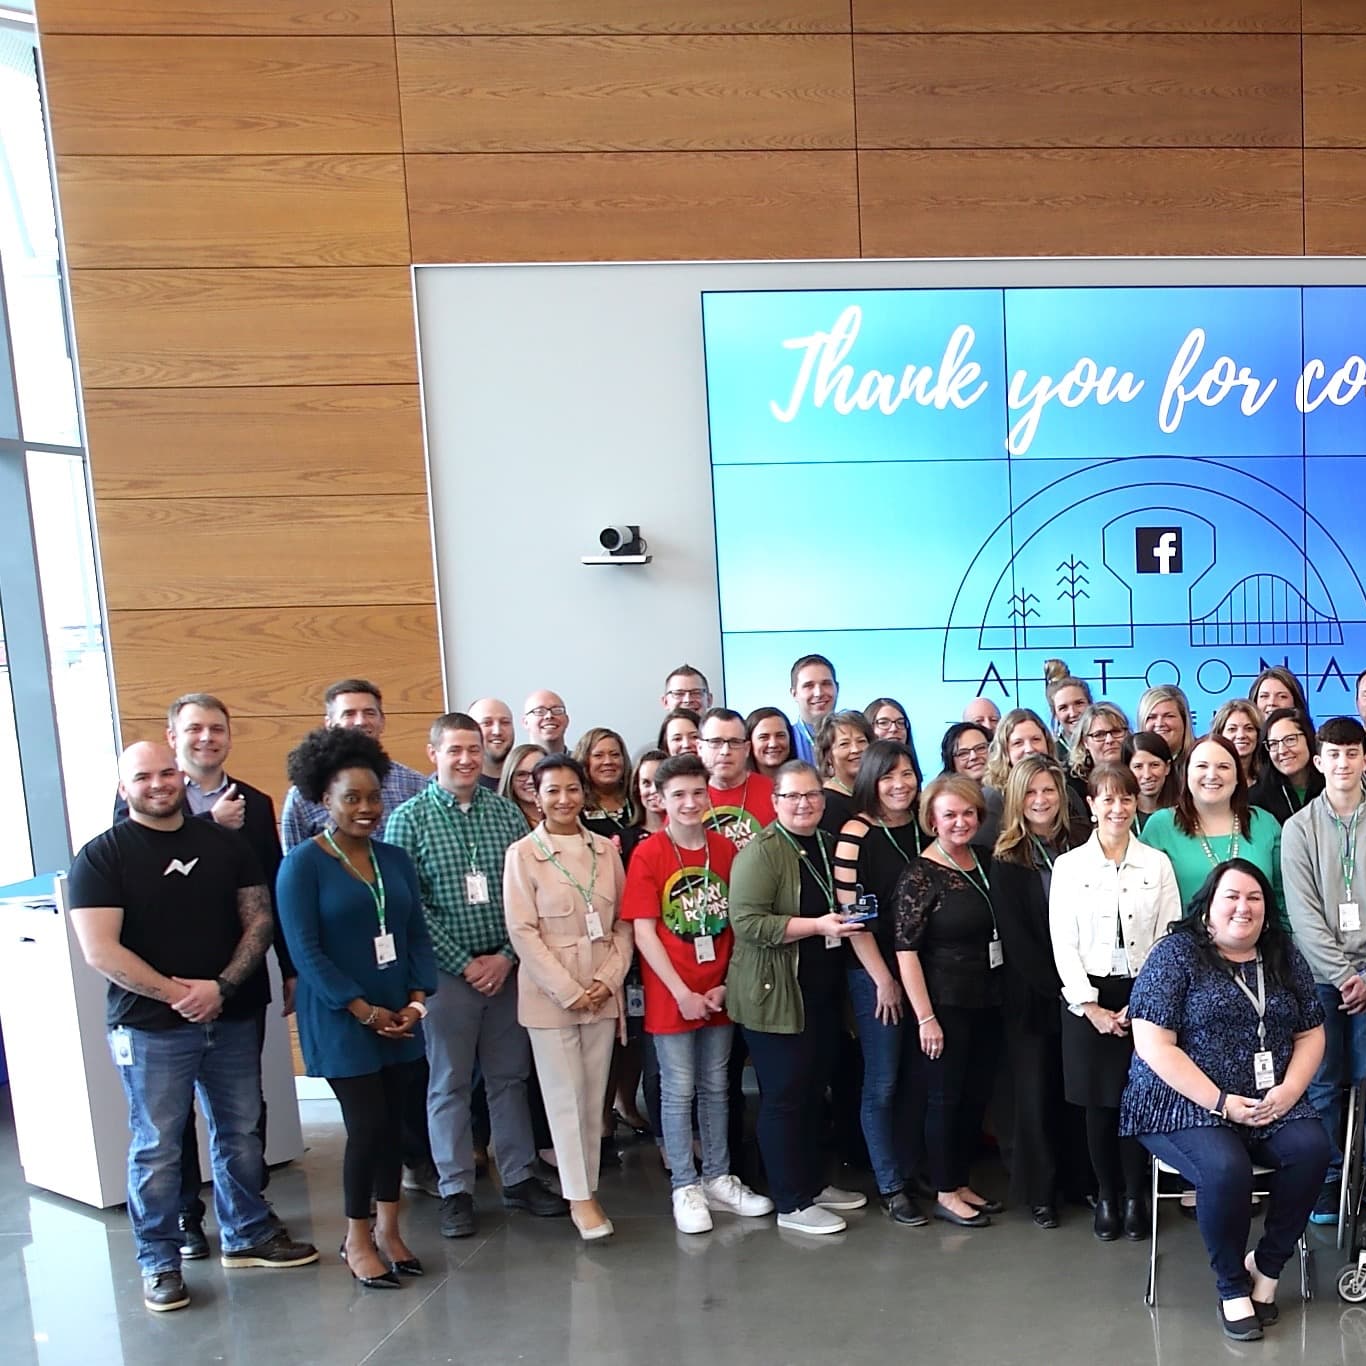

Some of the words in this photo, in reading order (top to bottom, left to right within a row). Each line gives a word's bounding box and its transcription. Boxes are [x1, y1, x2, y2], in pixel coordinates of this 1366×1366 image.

[770, 305, 988, 423] Thank
[1005, 356, 1145, 455] you
[1158, 327, 1278, 434] for
[976, 656, 1350, 697] ATOOA
[724, 818, 751, 840] ARY
[684, 897, 729, 922] POPINS
